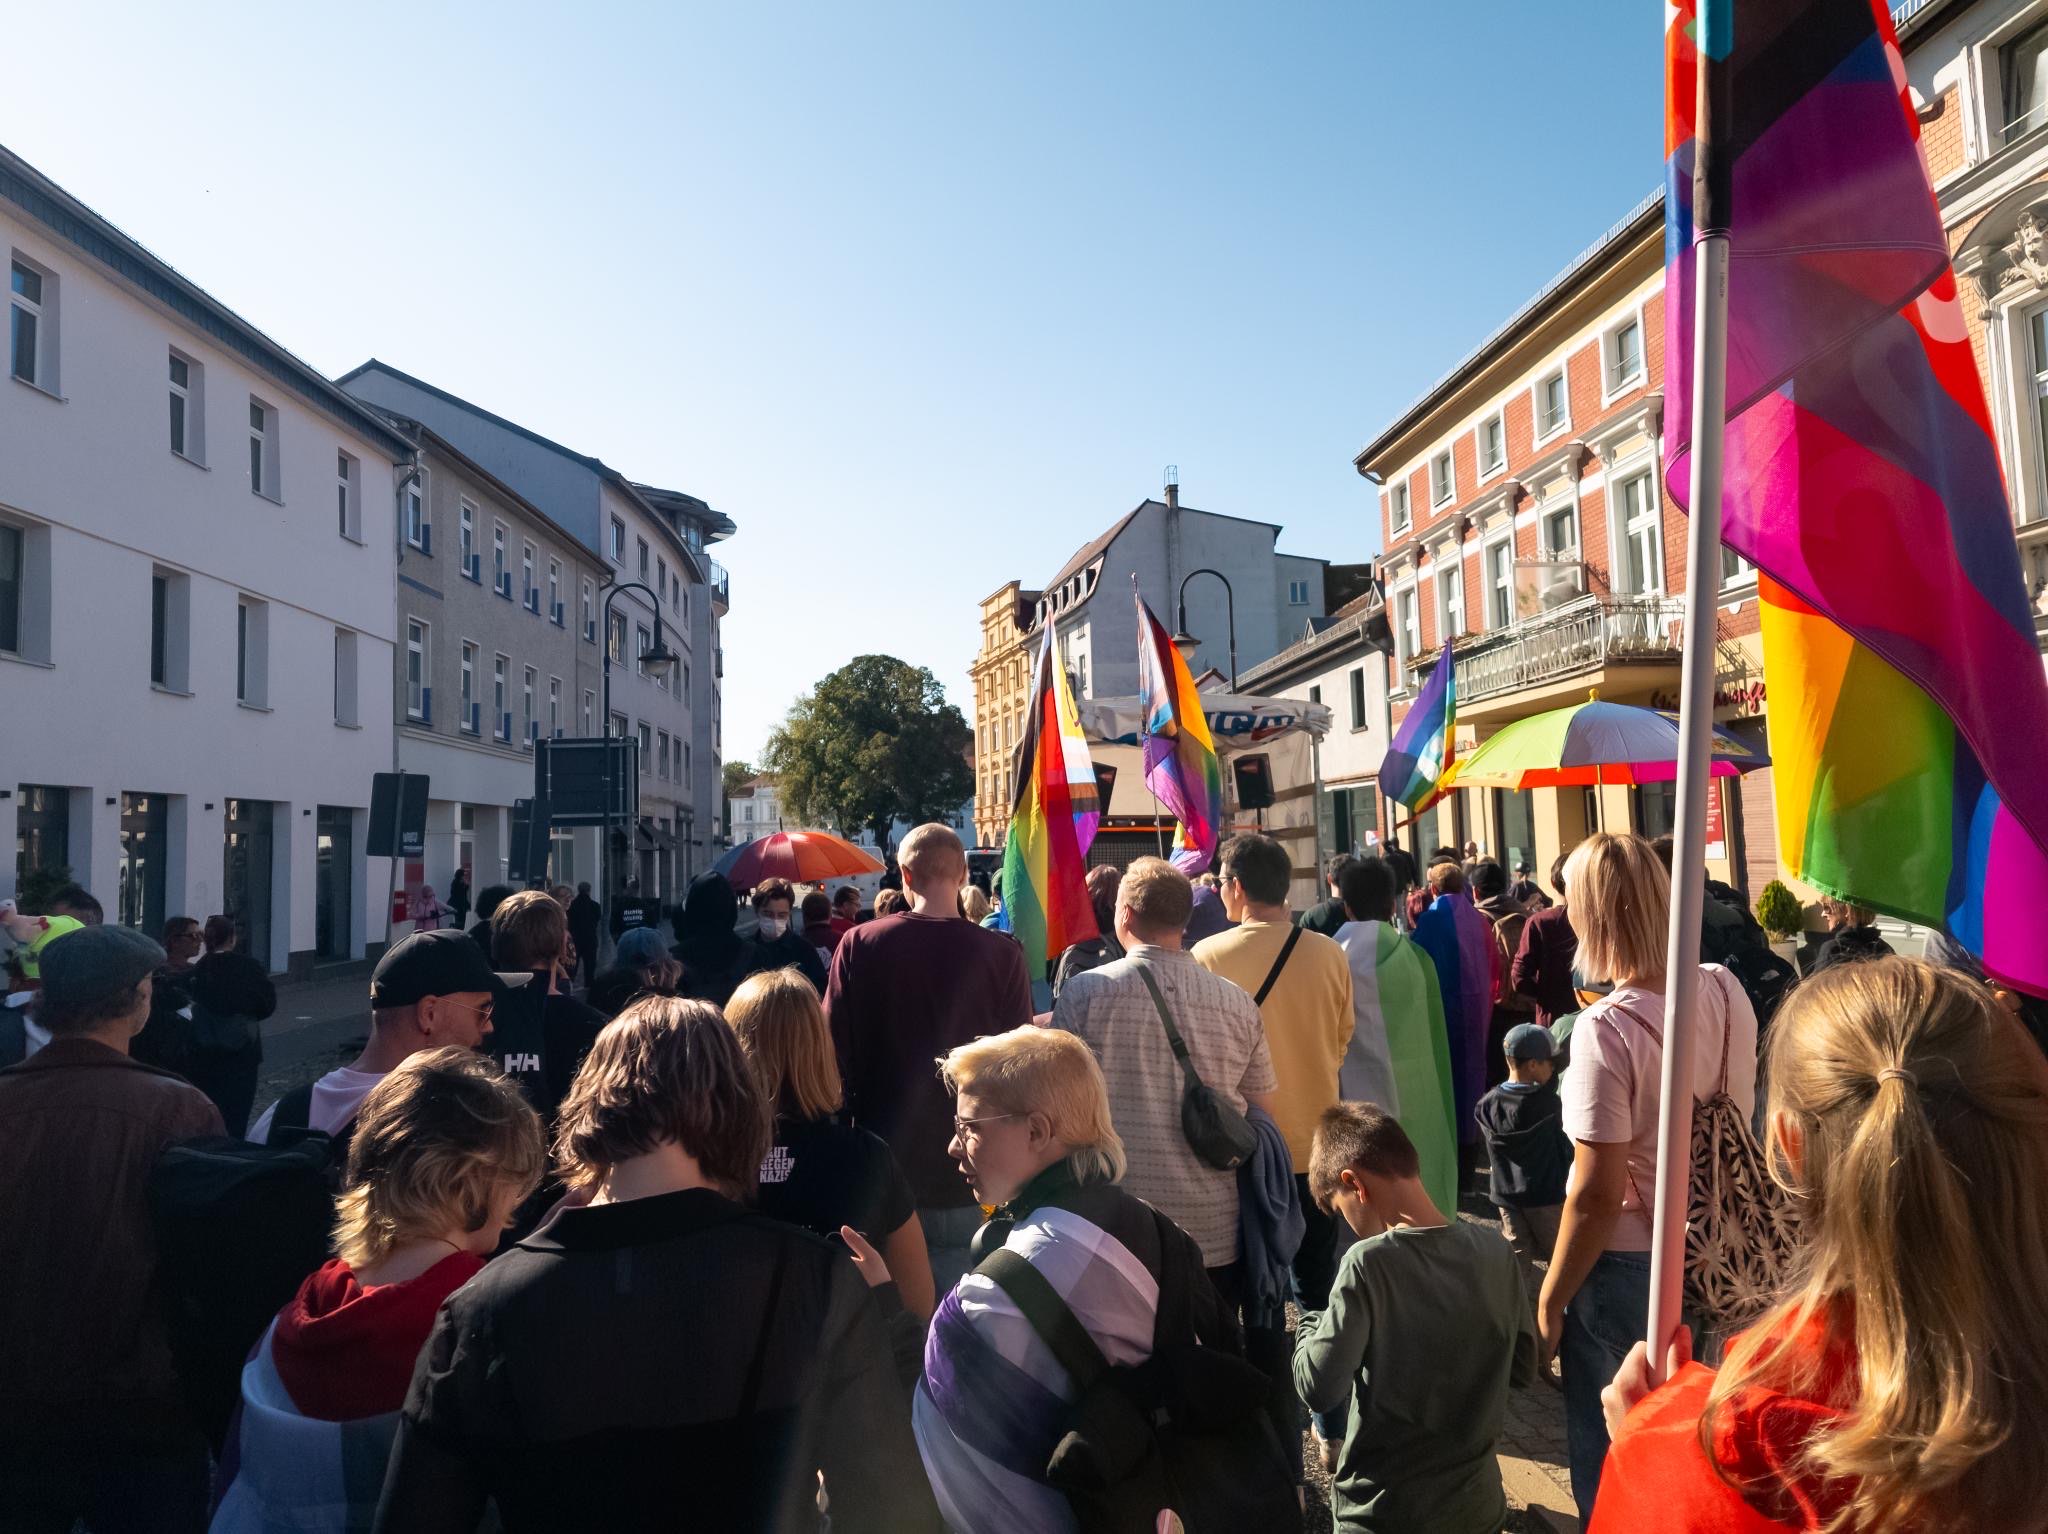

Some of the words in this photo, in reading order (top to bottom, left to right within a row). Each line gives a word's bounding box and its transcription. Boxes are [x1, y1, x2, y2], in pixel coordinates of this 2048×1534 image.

[766, 1146, 789, 1158] AUT
[760, 1157, 795, 1170] GEGEN
[759, 1169, 792, 1183] NAZIS
